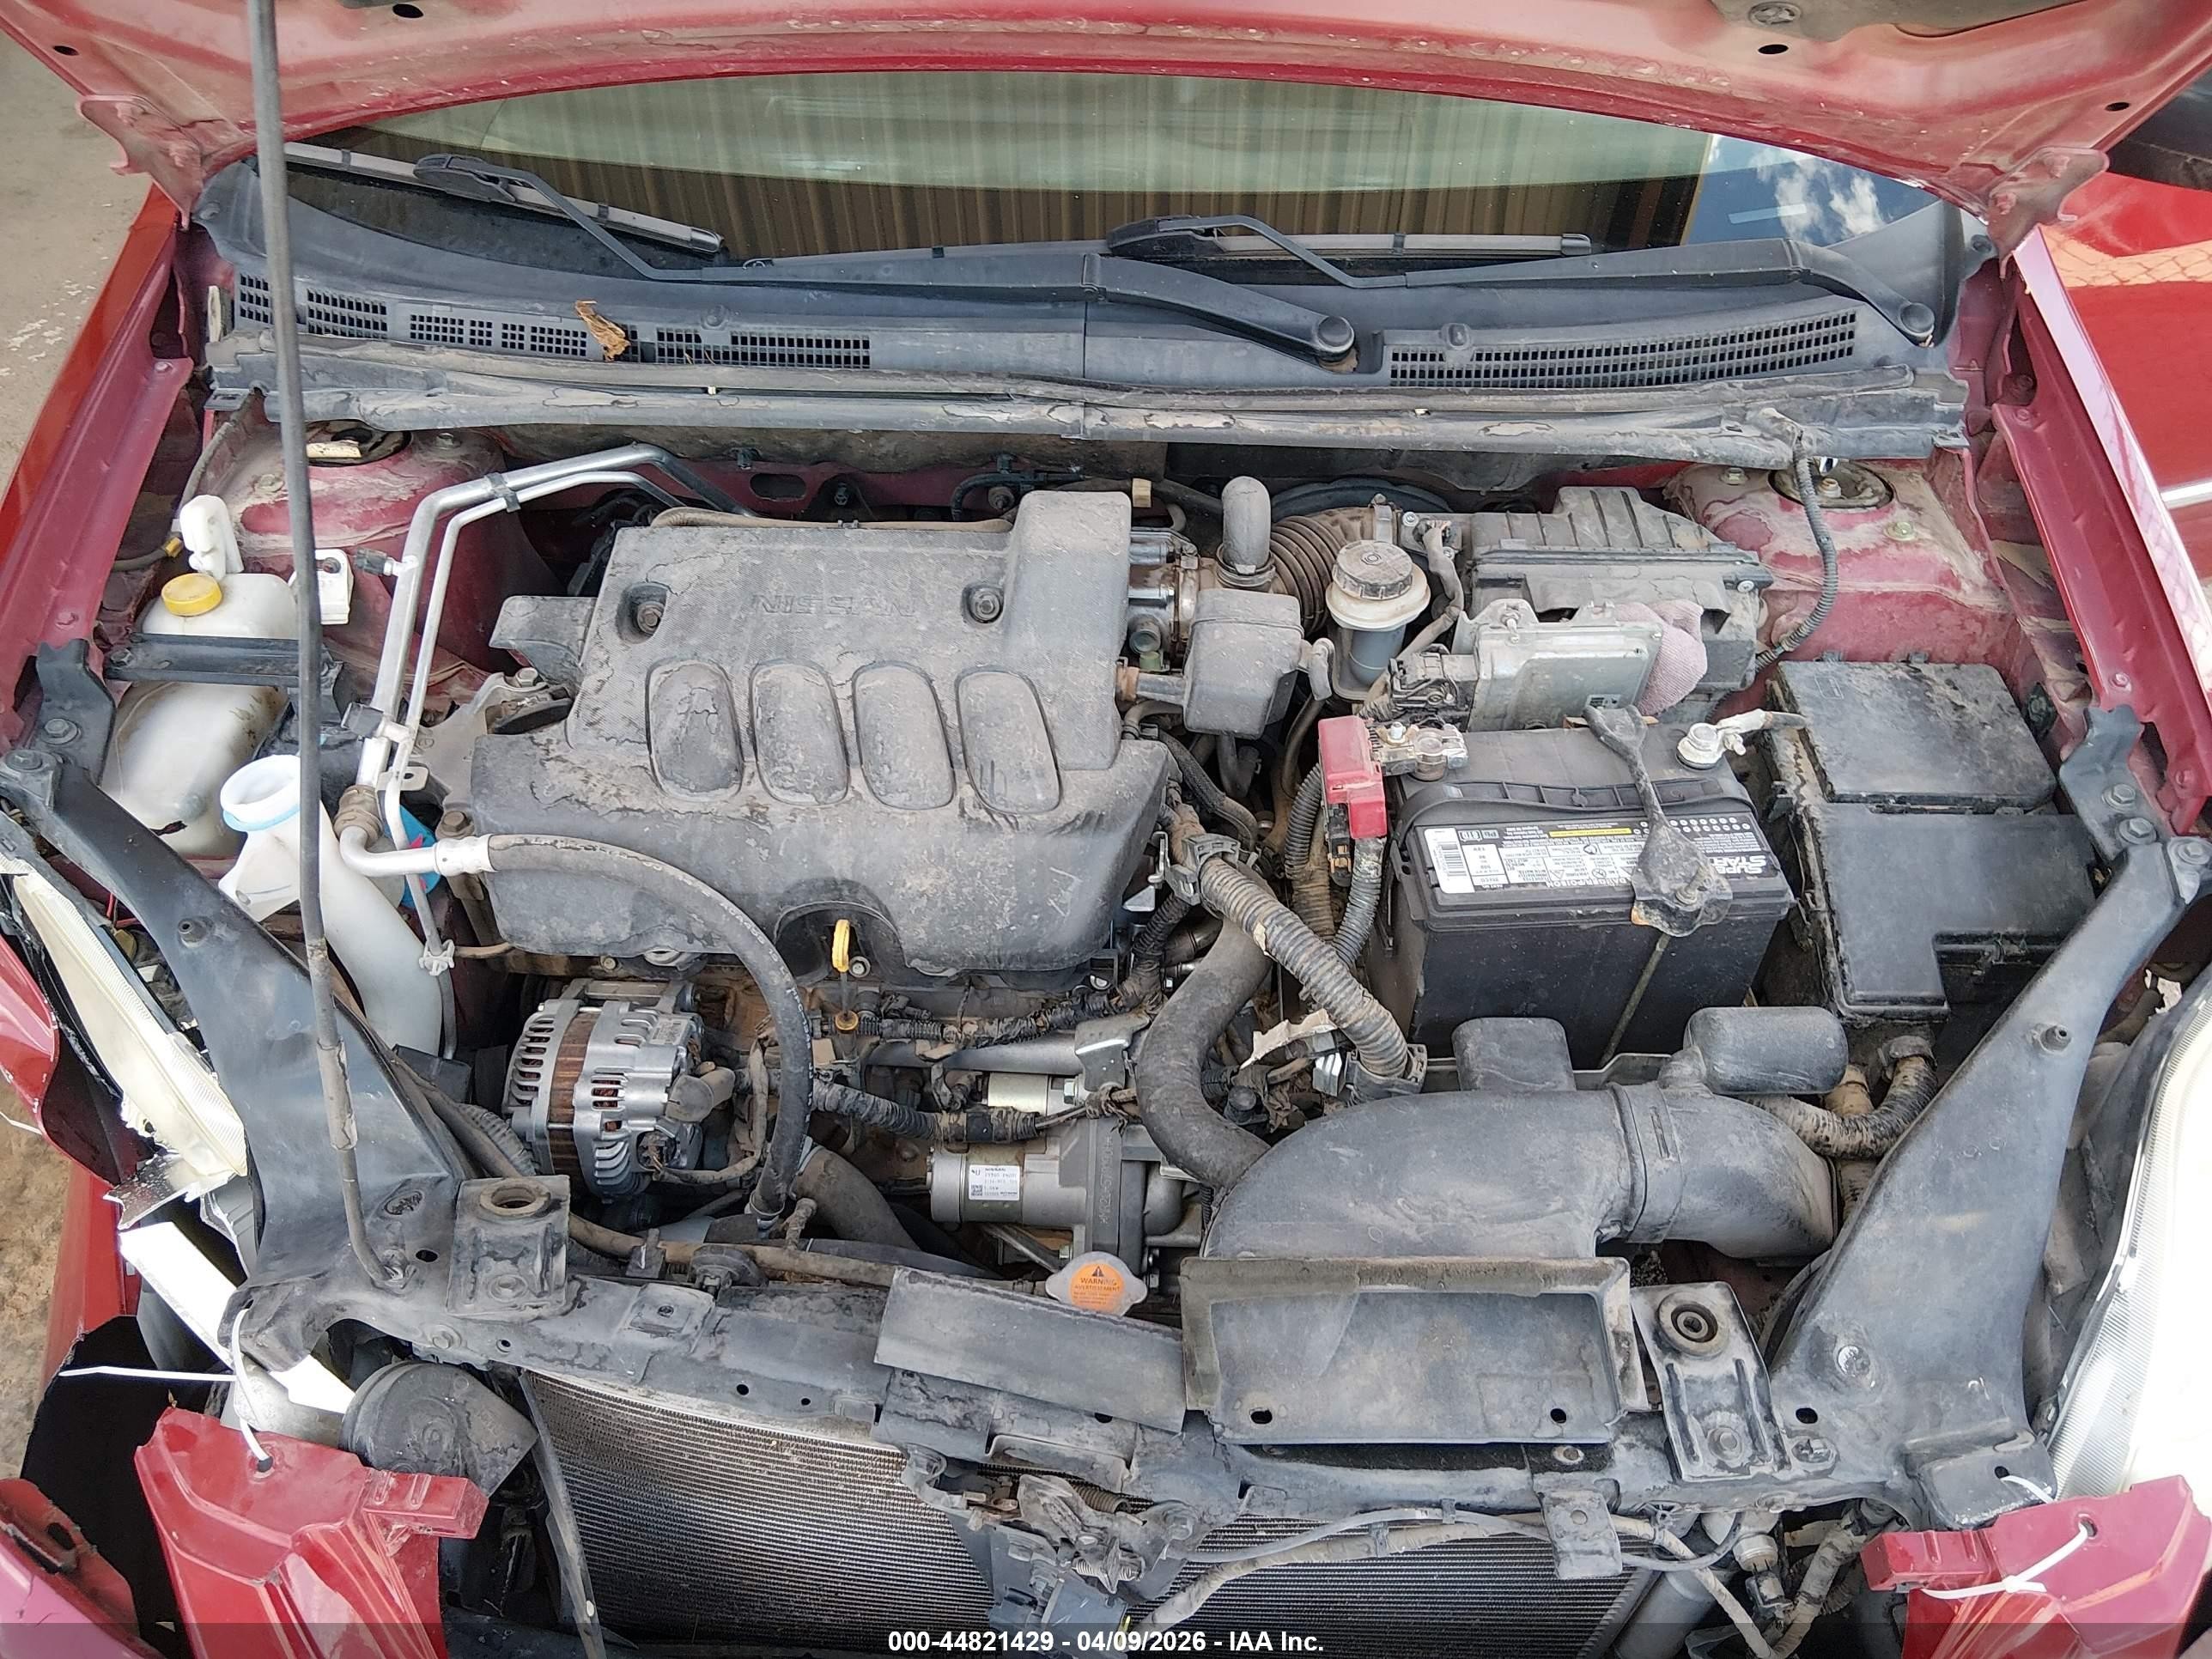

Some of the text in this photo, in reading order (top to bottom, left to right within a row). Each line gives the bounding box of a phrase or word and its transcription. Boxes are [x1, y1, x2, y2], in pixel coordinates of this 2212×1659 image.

[753, 594, 916, 617] NISSAN
[1711, 855, 1766, 866] STAR
[1715, 866, 1763, 874] SUPE
[1080, 1277, 1117, 1286] WARNING
